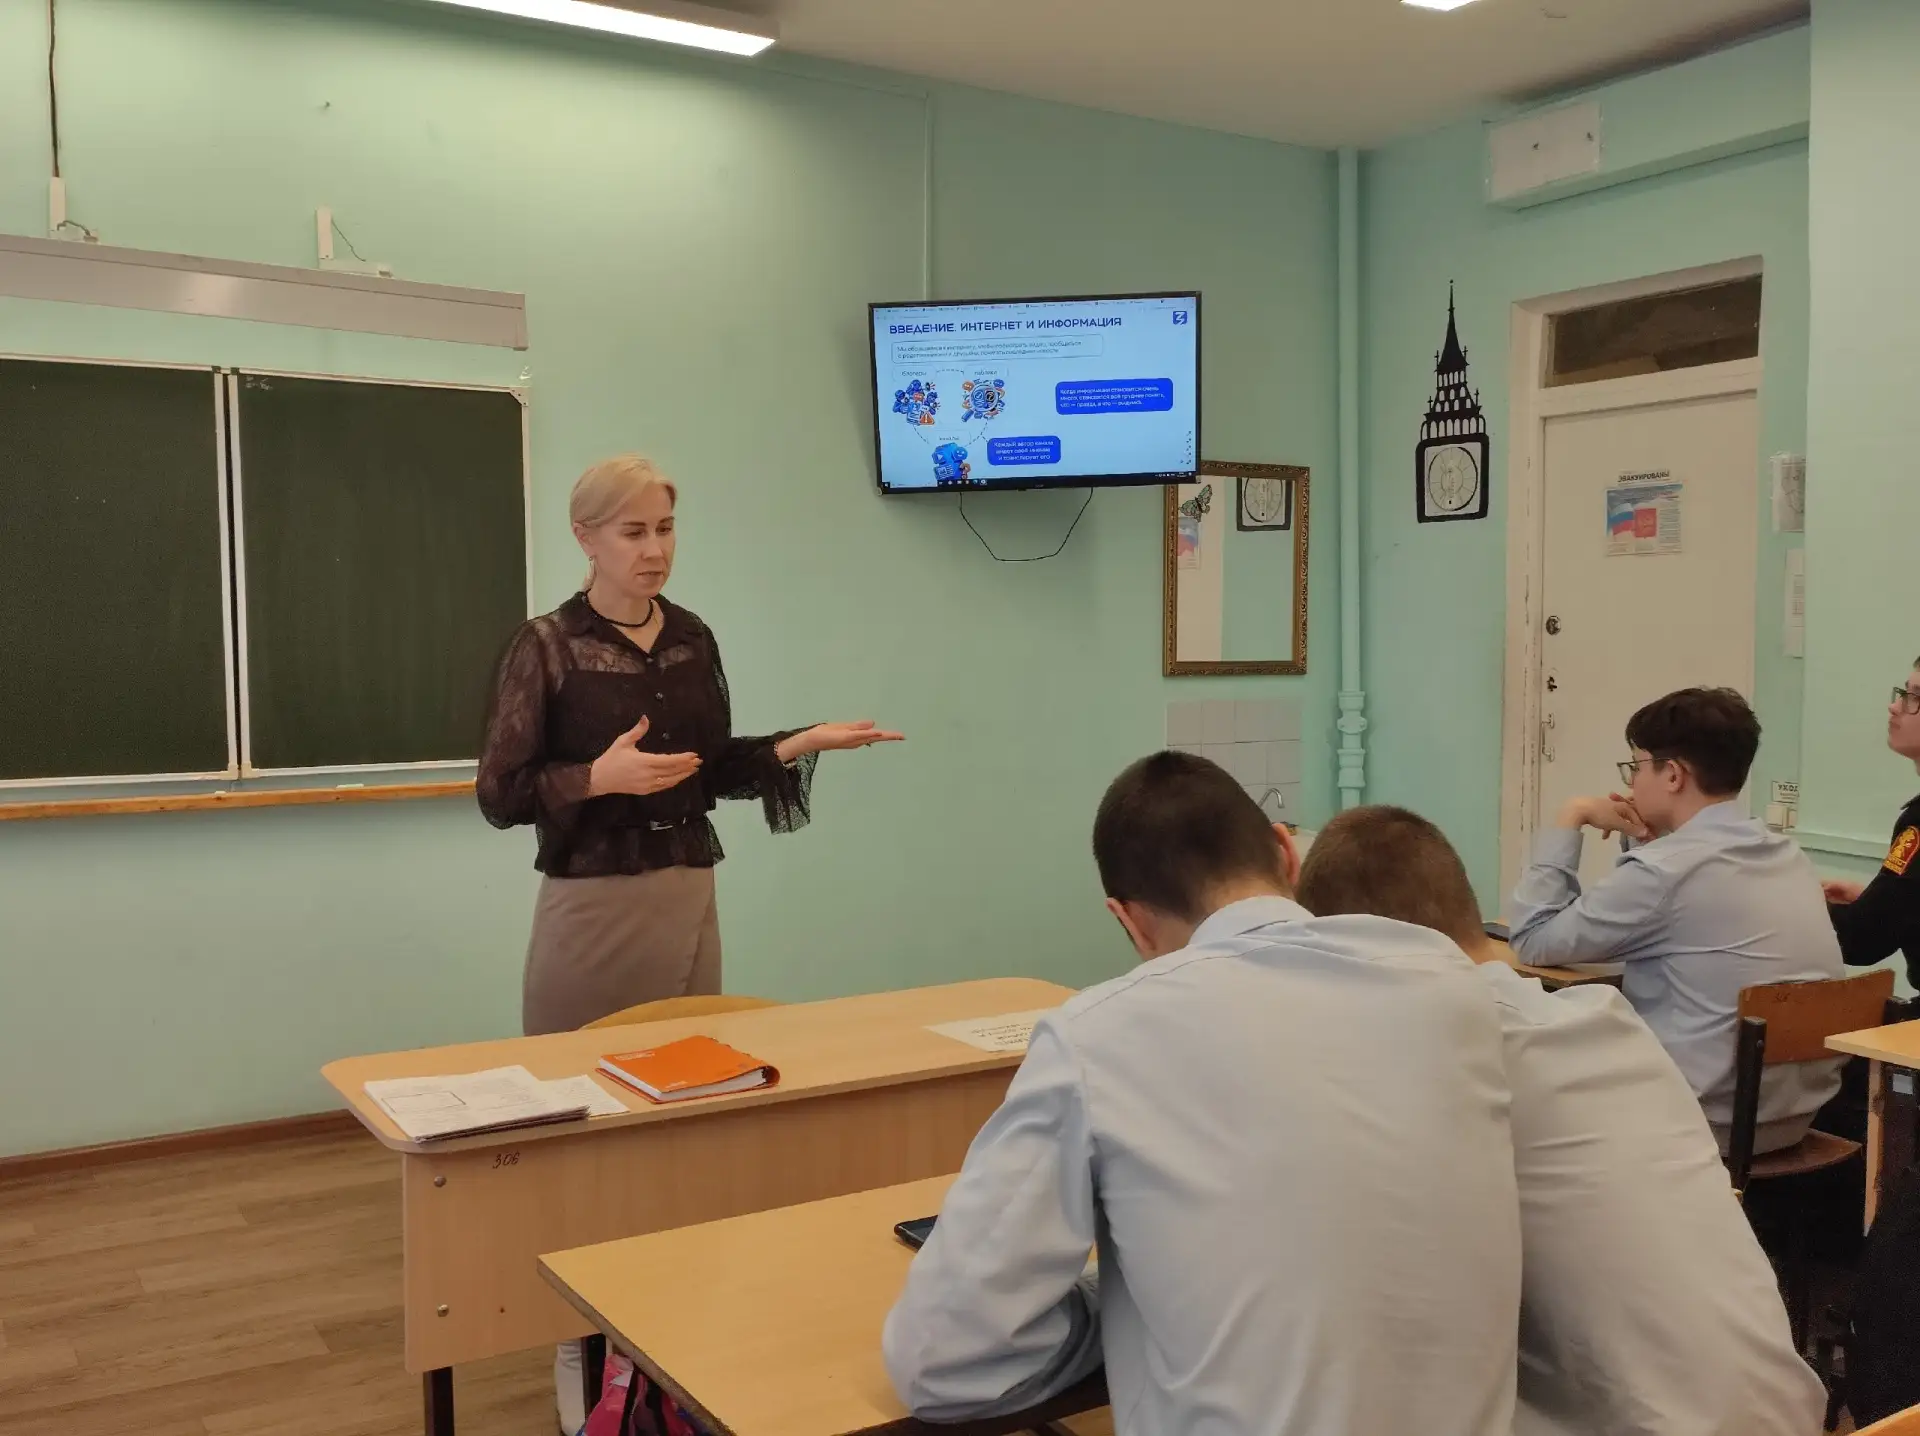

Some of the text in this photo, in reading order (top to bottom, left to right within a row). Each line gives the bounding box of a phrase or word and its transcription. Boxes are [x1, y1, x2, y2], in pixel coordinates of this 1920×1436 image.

[889, 317, 1122, 334] ВВЕДЕНИЕ. ИНТЕРНЕТ И ИНФОРМАЦИЯ
